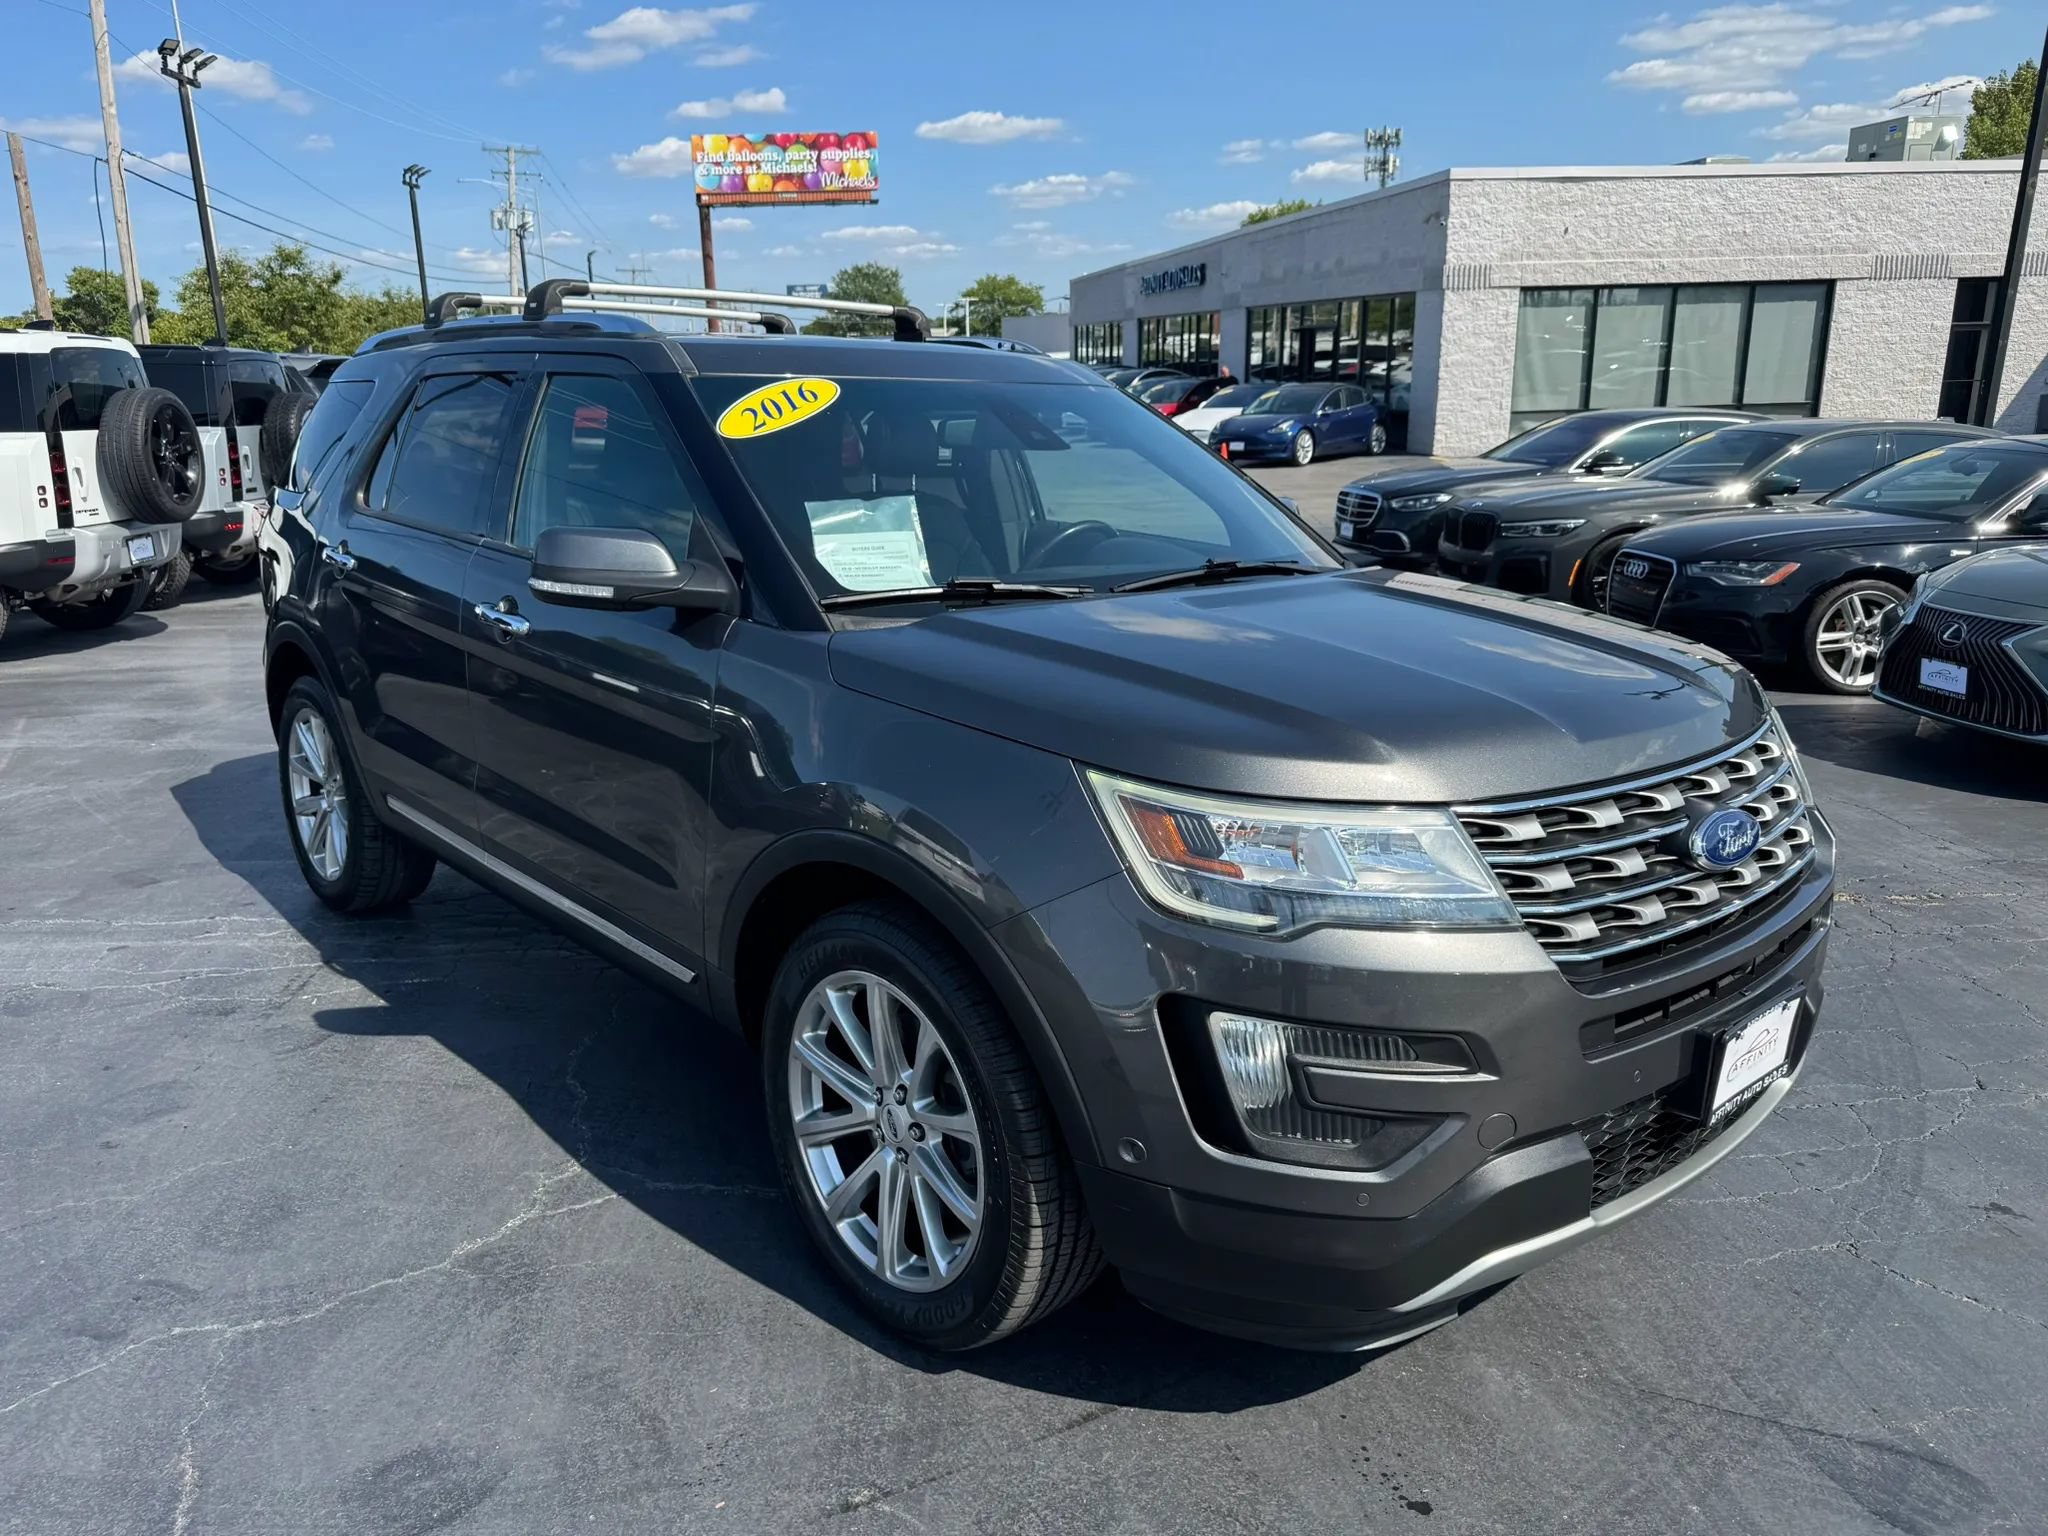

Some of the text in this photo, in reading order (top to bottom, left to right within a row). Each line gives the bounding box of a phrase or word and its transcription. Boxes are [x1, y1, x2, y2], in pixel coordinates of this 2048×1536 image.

[697, 147, 874, 162] Find balloons, party supplies,
[699, 160, 818, 175] & more at Michaels!
[822, 170, 875, 189] Michaels
[741, 382, 819, 431] 2016
[1718, 819, 1754, 857] Ford
[1731, 1038, 1778, 1074] AFFINITY
[1710, 1064, 1788, 1126] AFFINITY AUTO SALES
